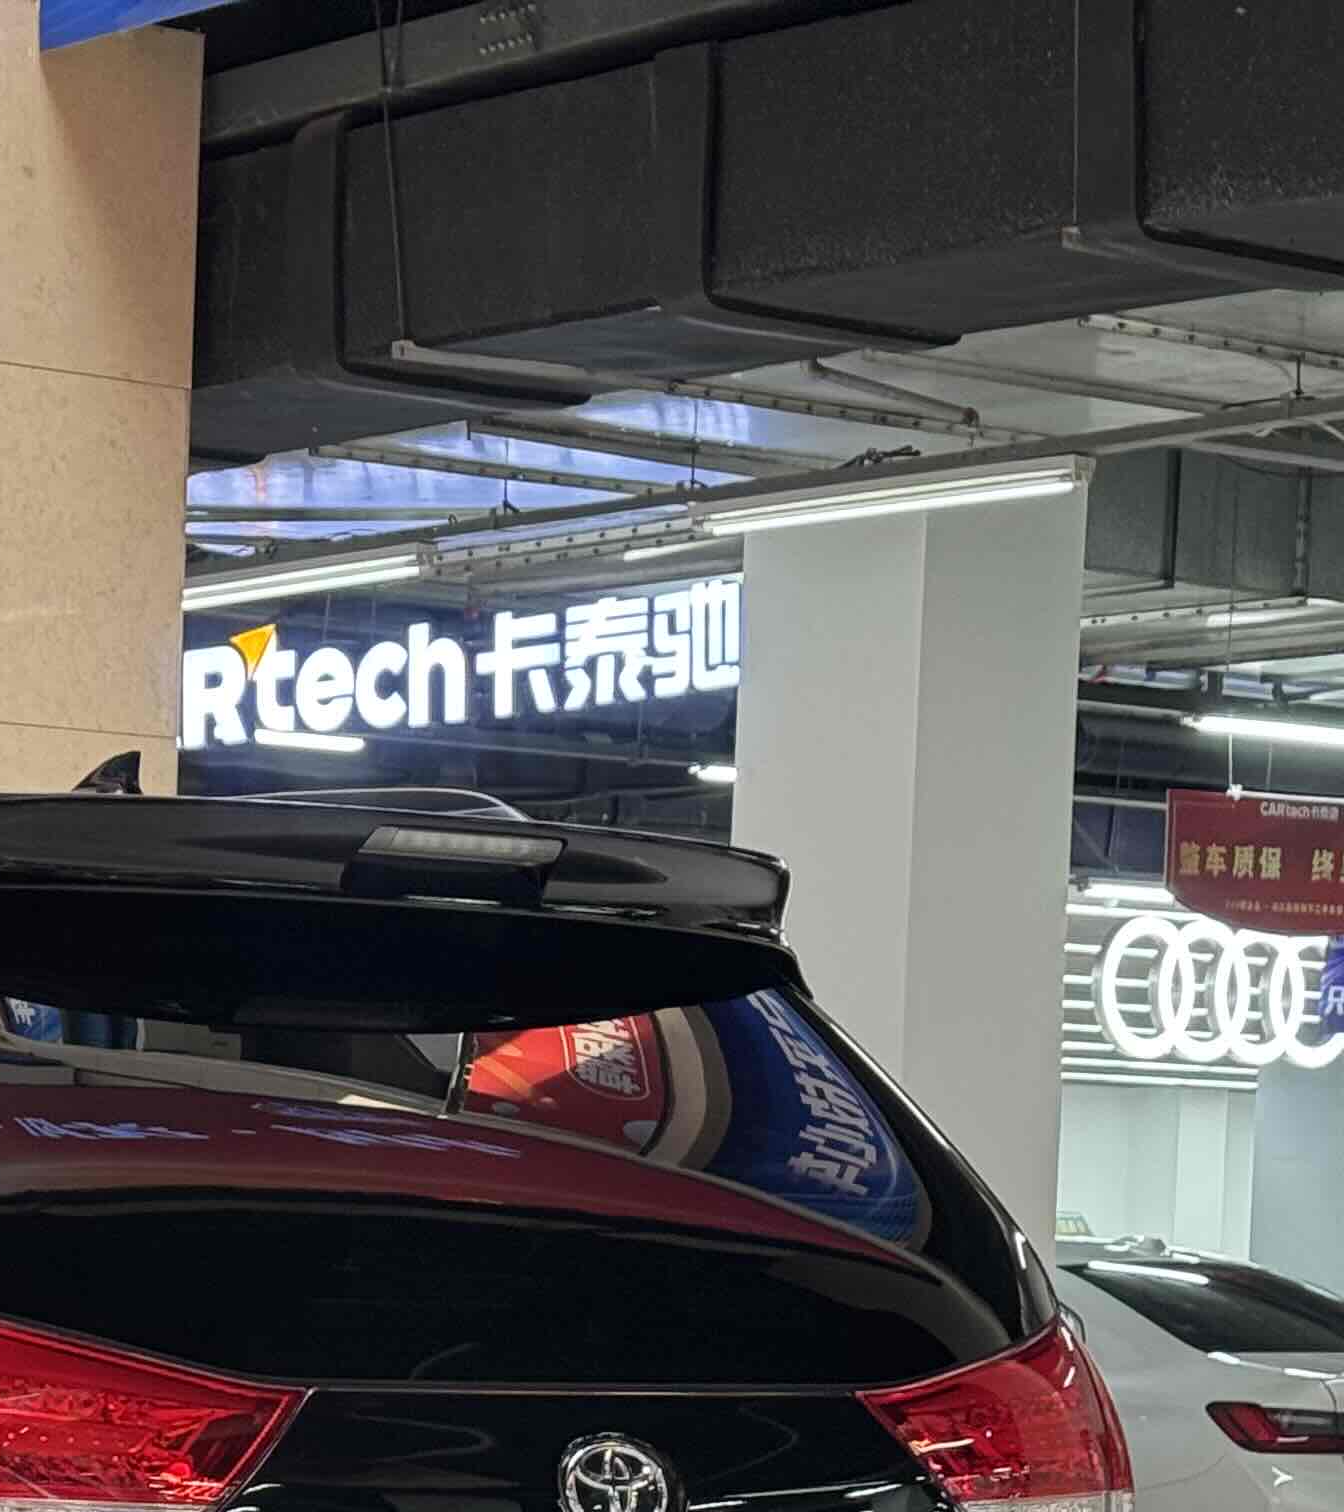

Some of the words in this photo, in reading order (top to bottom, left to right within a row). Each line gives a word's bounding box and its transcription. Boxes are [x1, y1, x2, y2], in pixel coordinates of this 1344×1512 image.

[178, 622, 469, 751] Rtech
[476, 578, 743, 719] 卡泰驰
